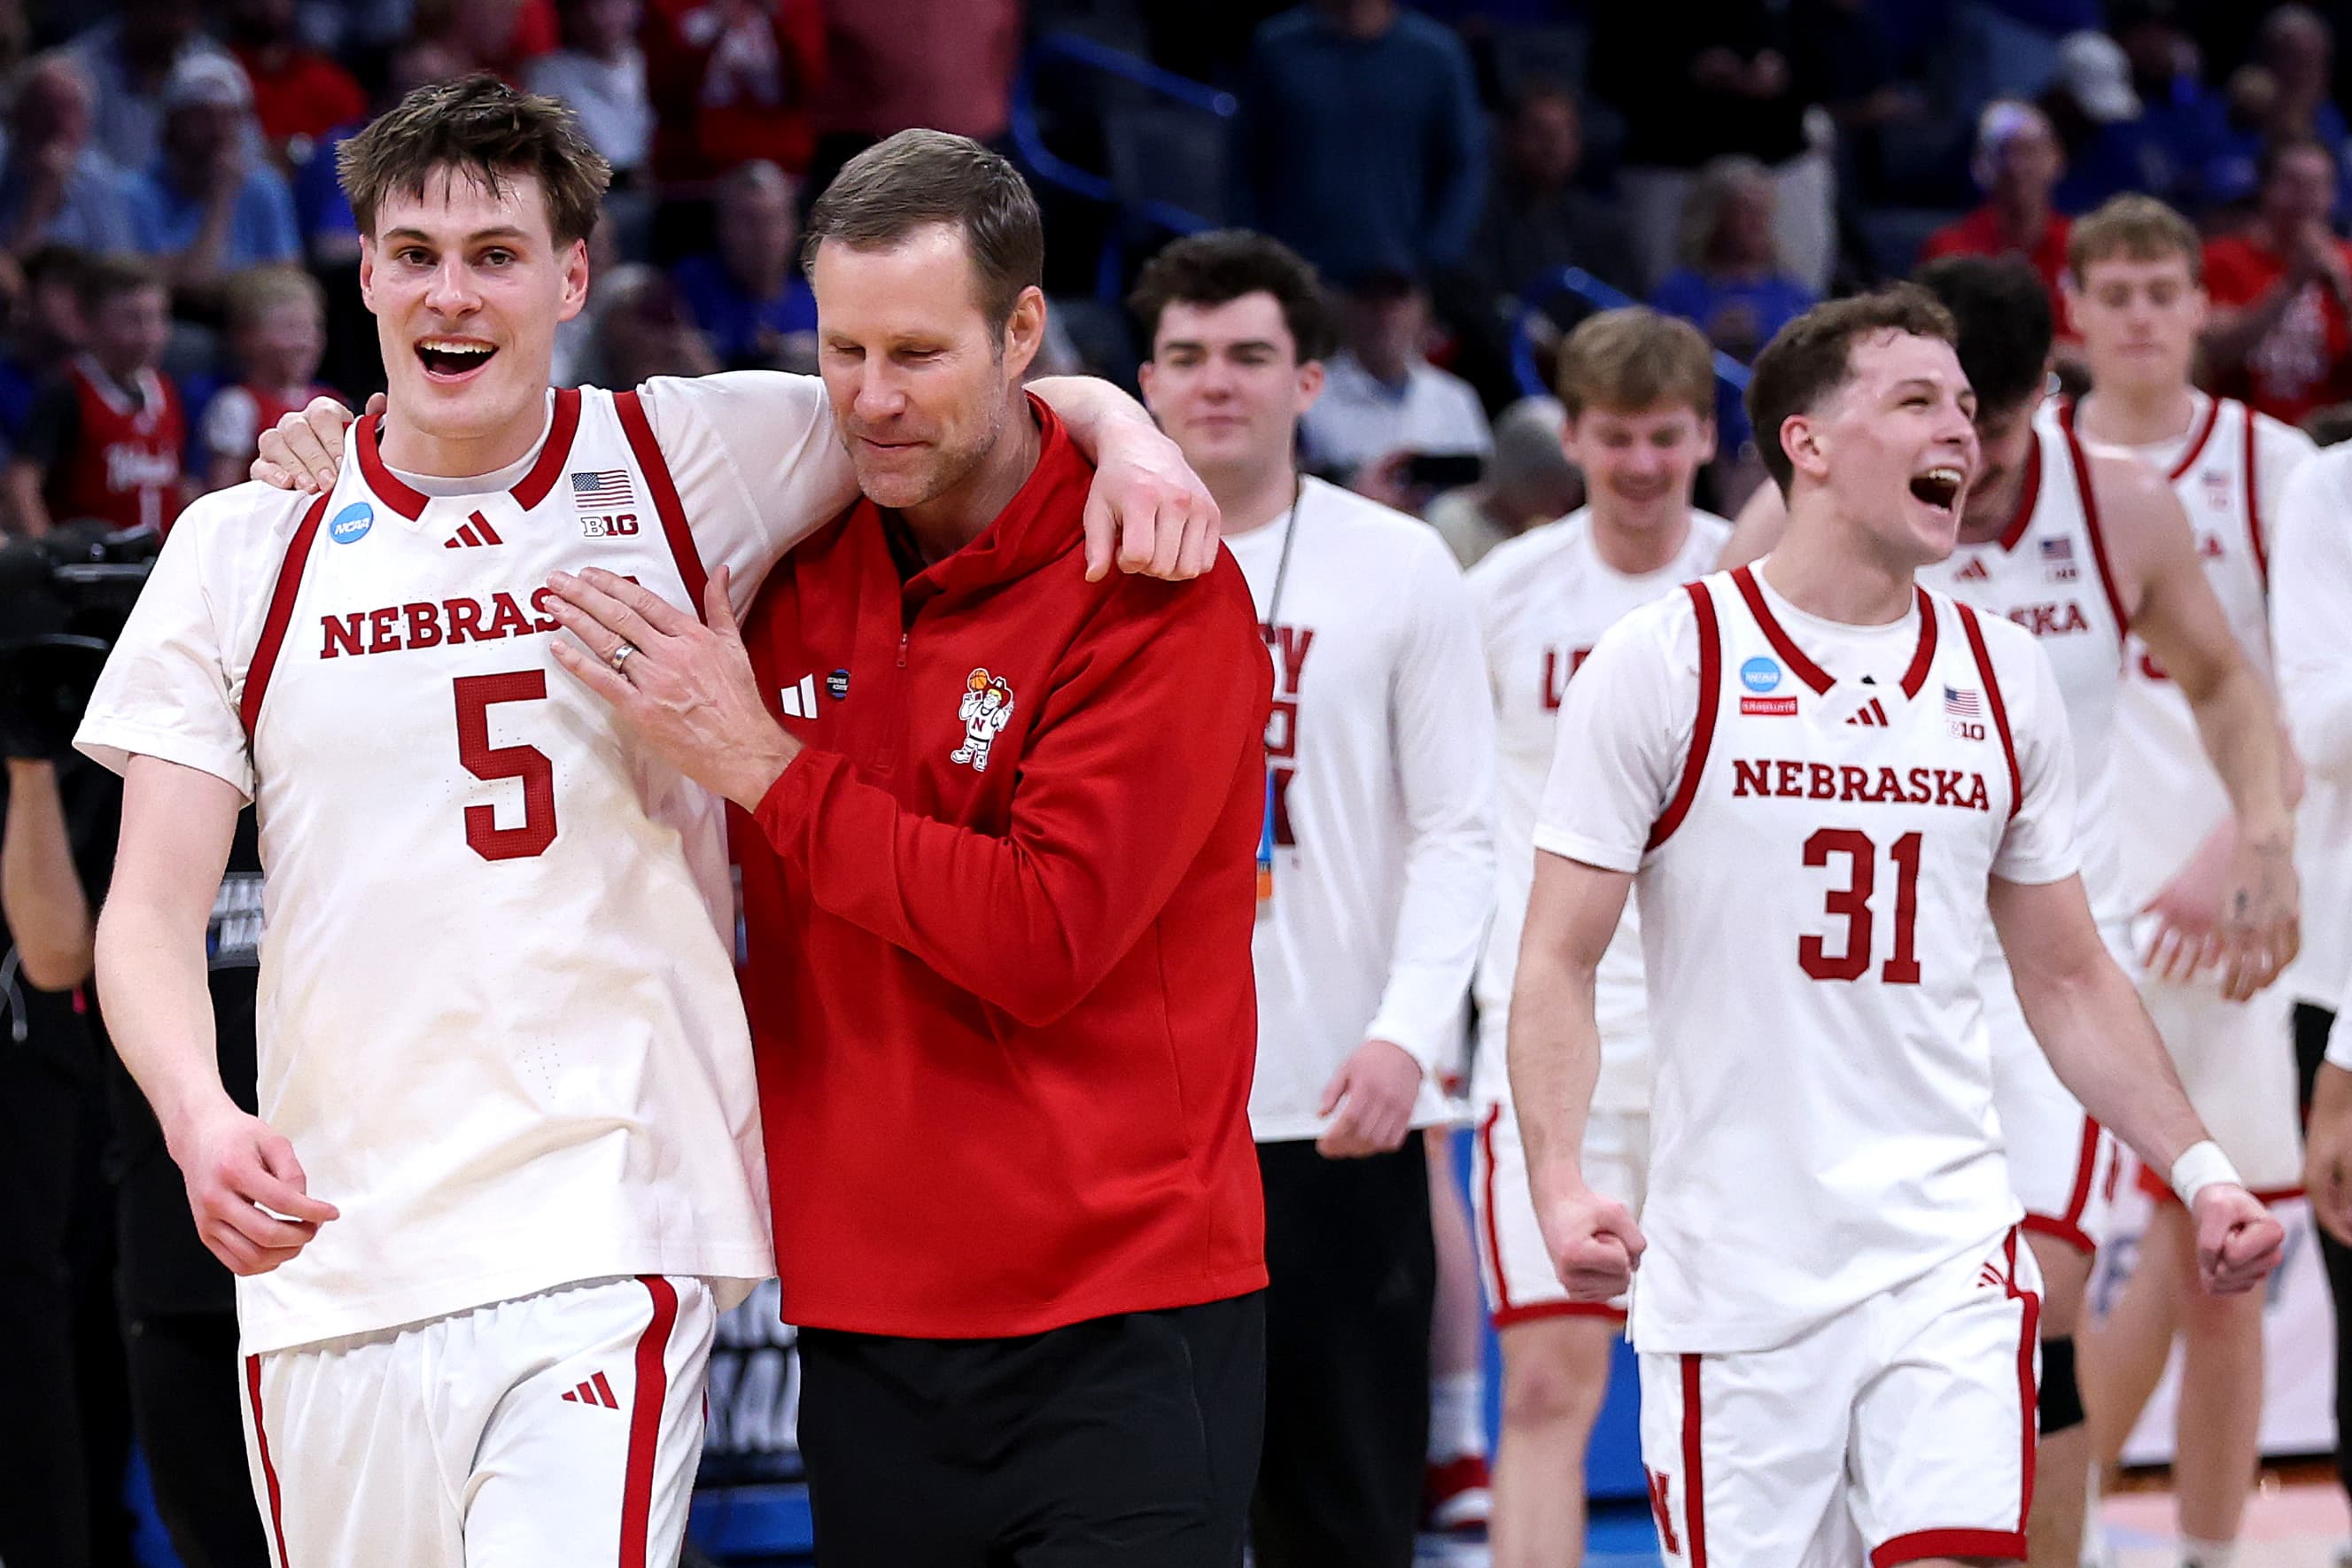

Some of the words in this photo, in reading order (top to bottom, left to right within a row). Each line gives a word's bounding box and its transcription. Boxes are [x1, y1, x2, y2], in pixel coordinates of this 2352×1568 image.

[334, 516, 370, 536] NCAA
[320, 574, 641, 659] NEBRAS
[971, 717, 986, 733] N
[453, 668, 558, 862] 5
[1732, 759, 1990, 812] NEBRASKA
[1798, 827, 1922, 984] 31
